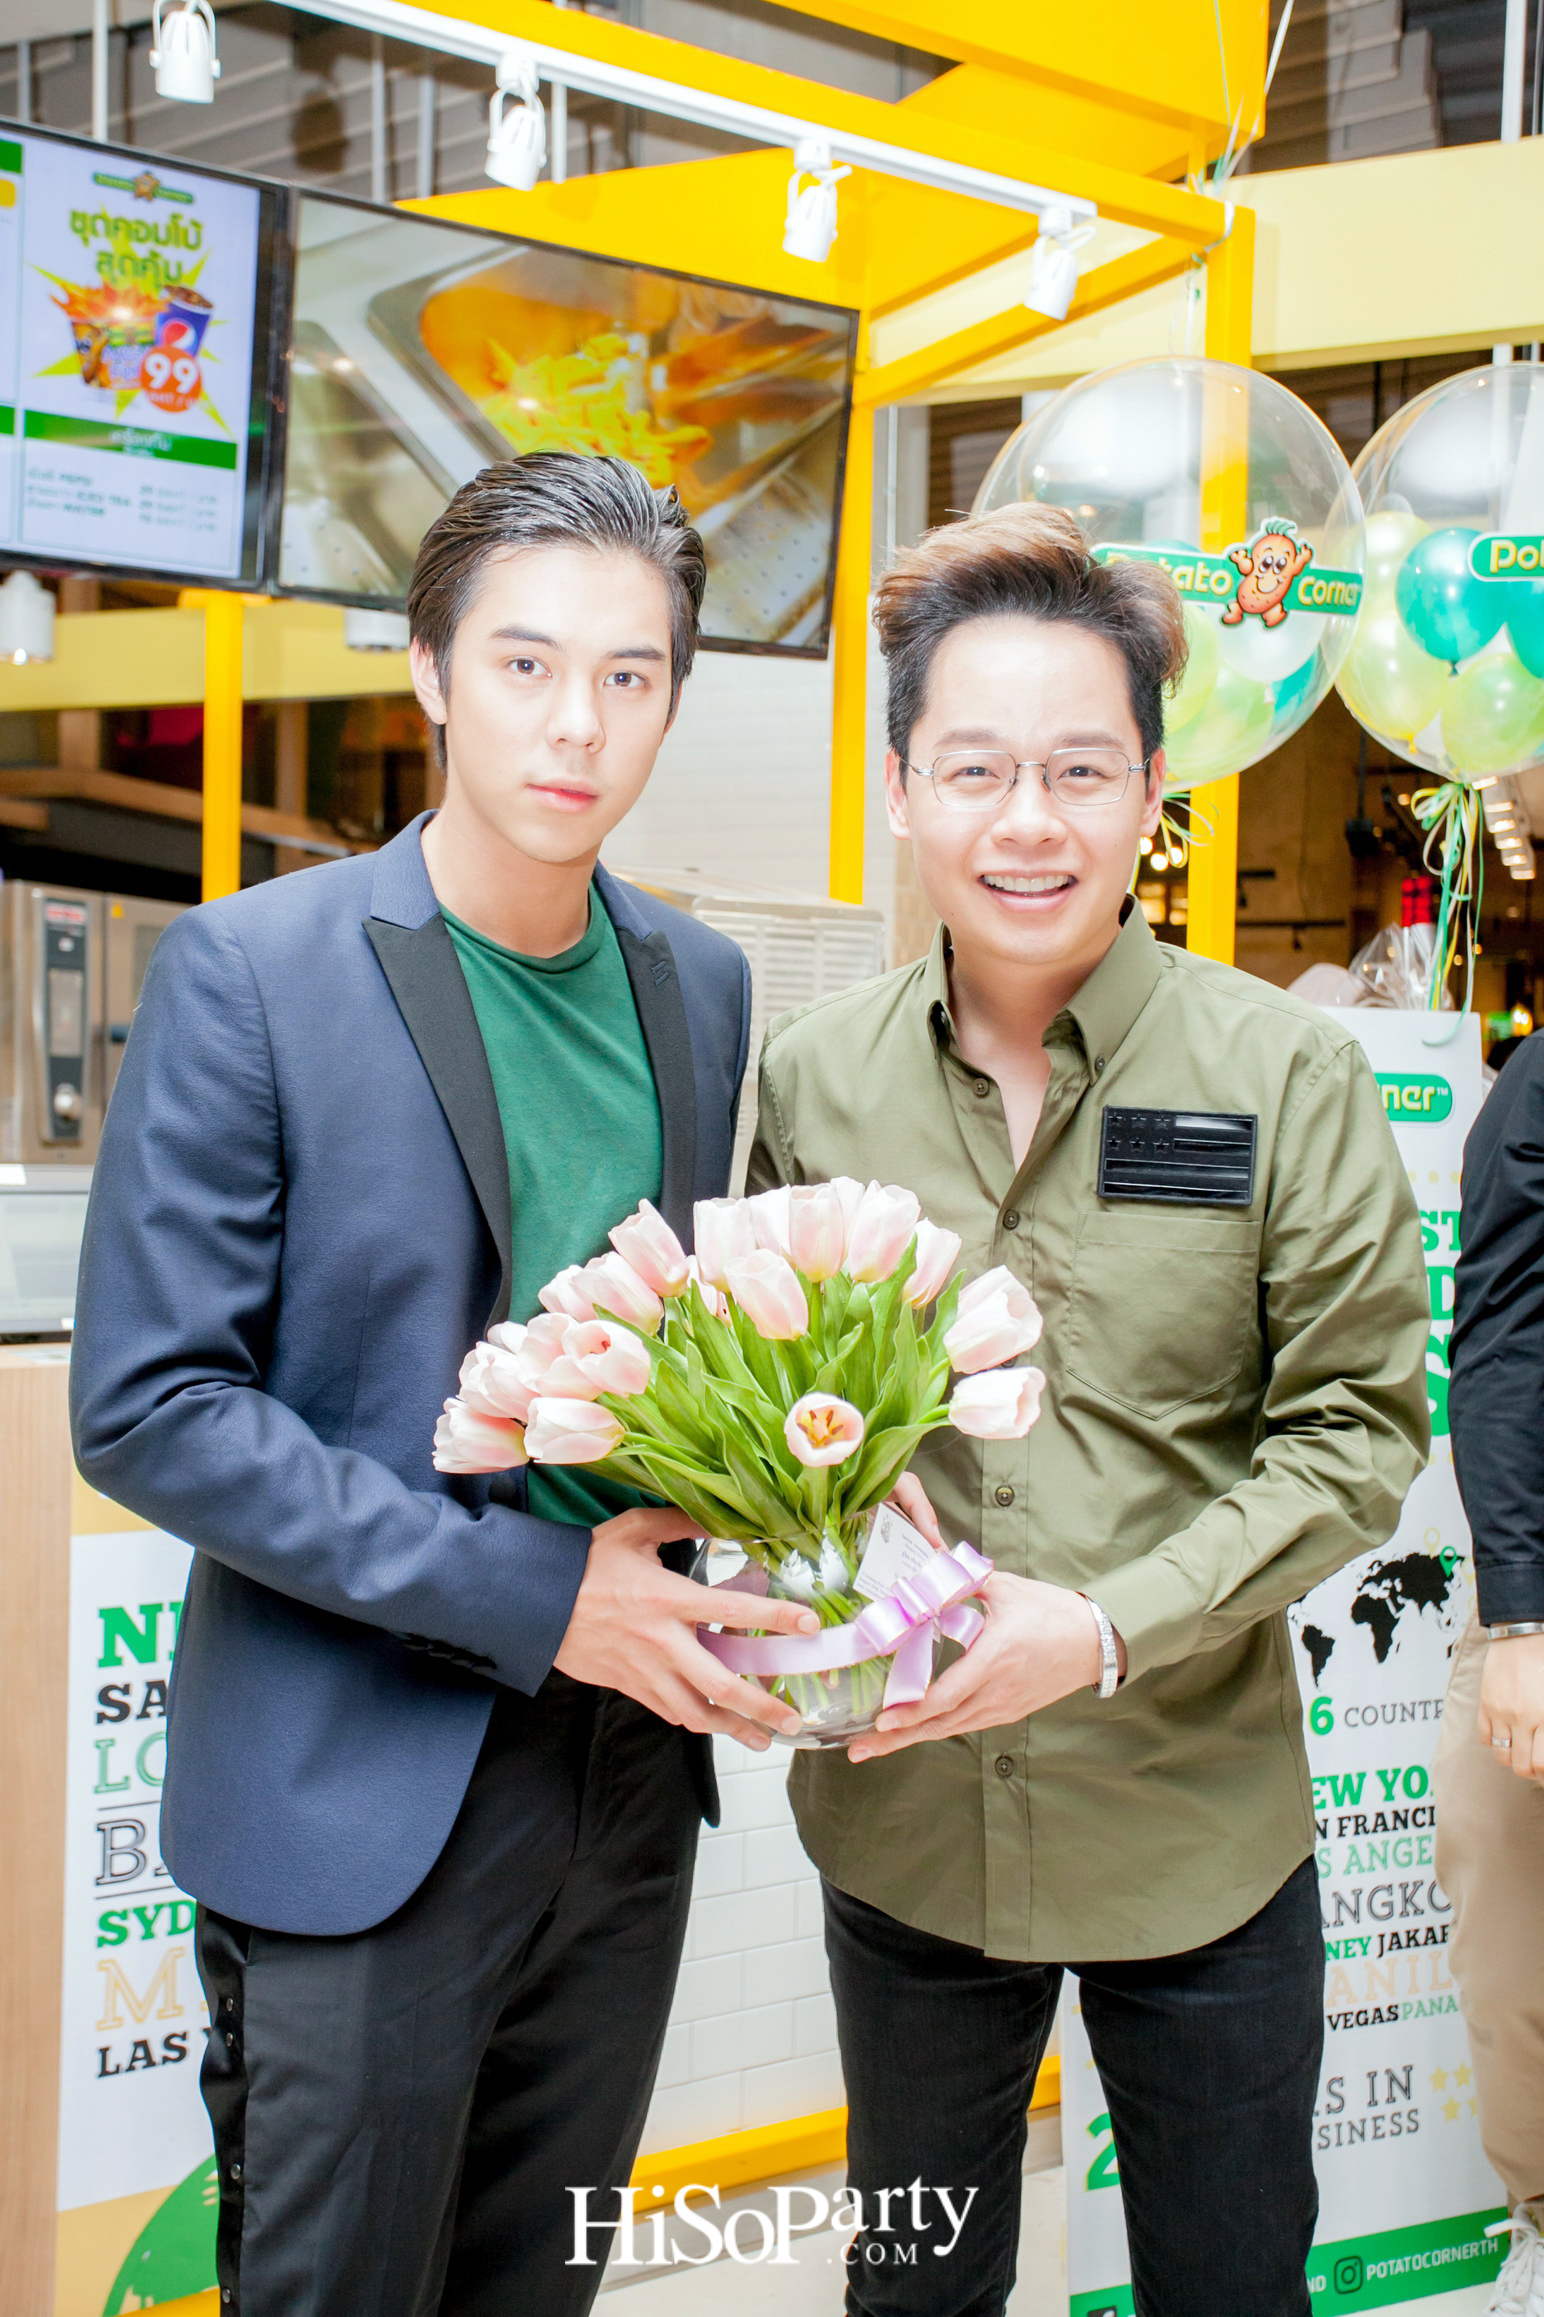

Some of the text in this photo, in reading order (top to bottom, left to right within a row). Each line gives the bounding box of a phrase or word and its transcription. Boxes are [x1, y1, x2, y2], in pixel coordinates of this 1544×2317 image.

[145, 353, 199, 394] 99
[1490, 539, 1544, 574] Po
[1376, 1765, 1434, 1802] YO
[1343, 1834, 1432, 1876] ANGE
[97, 1900, 196, 1948] SYD
[1322, 1879, 1453, 1929] NGKO
[1326, 1936, 1372, 1961] NEY
[1327, 1994, 1459, 2031] VEGAS PANA
[97, 2030, 188, 2079] LAS
[1367, 2064, 1414, 2107] IN
[1317, 2108, 1420, 2151] SINESS
[1366, 2238, 1499, 2281] POTATOCORNERTH
